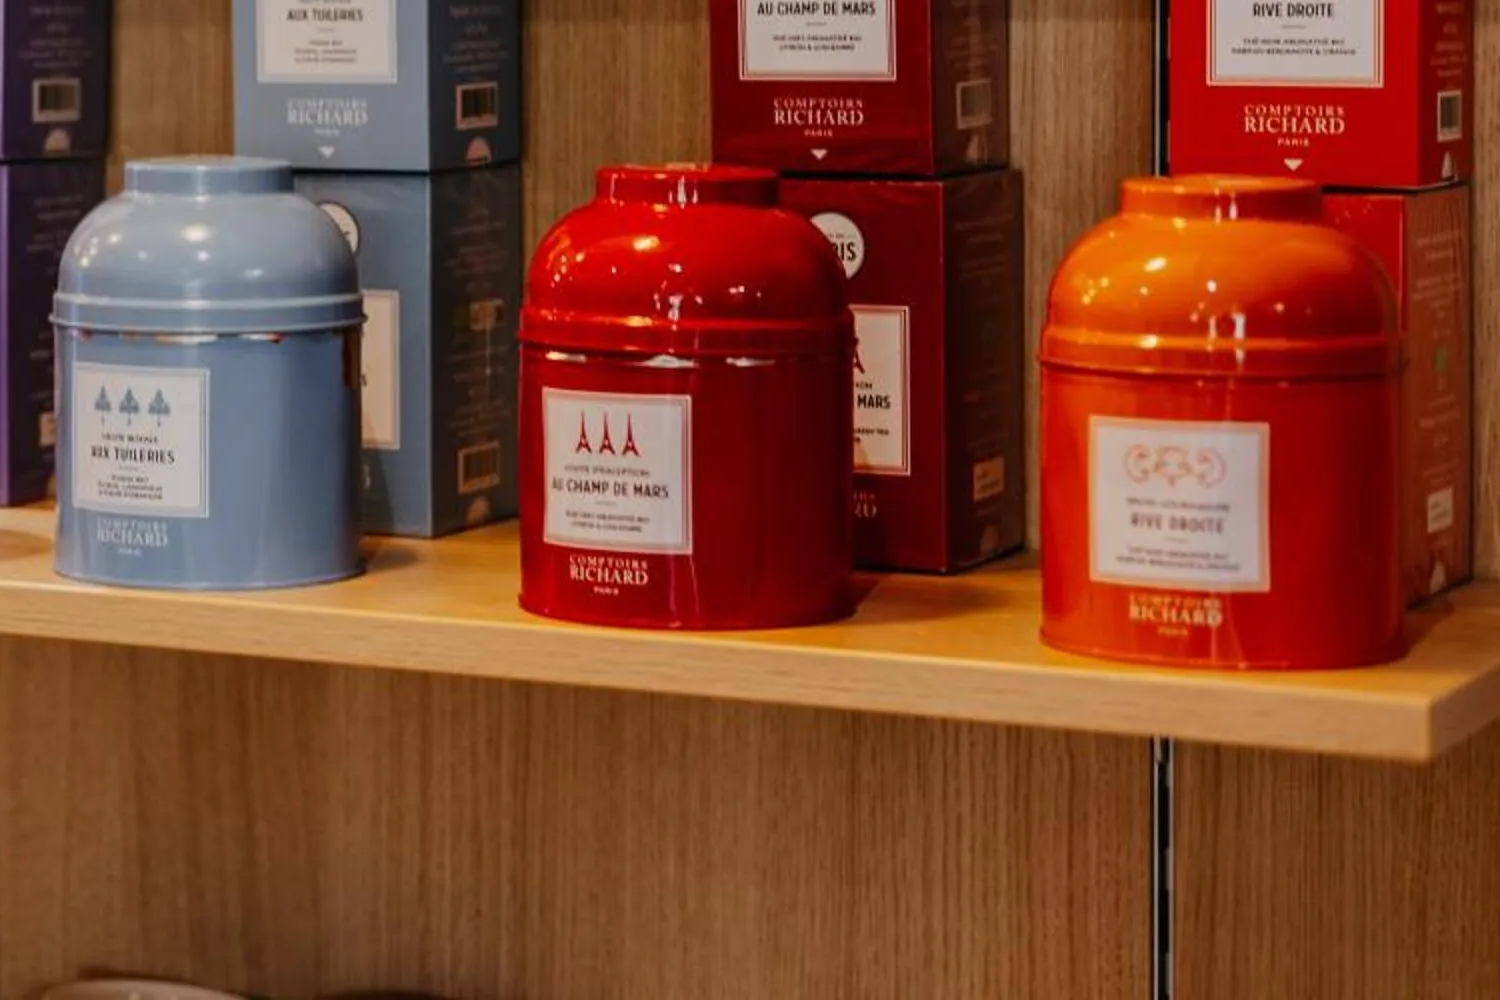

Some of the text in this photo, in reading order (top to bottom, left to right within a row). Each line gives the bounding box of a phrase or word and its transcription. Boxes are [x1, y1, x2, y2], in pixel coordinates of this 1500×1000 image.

[287, 8, 363, 21] AUX TUILERIES
[757, 1, 876, 17] AU CHAMP DE MARS
[1253, 2, 1334, 18] RIVE DROITE
[773, 97, 864, 109] COMPTOIRS
[1244, 103, 1345, 117] COMPTOIRS
[287, 108, 368, 125] RICHARD
[773, 108, 864, 126] RICHARD
[1244, 115, 1345, 135] RICHARD
[857, 394, 891, 409] MARS
[114, 446, 175, 465] TUILERIES
[566, 479, 609, 495] CHAMP
[613, 481, 628, 497] DE
[633, 483, 669, 499] MARS
[1130, 511, 1224, 536] RIVE DROITE
[97, 527, 168, 547] RICHARD
[569, 553, 648, 570] COMPTOIRS
[569, 565, 650, 586] RICHARD
[1128, 604, 1224, 628] RICHARD
